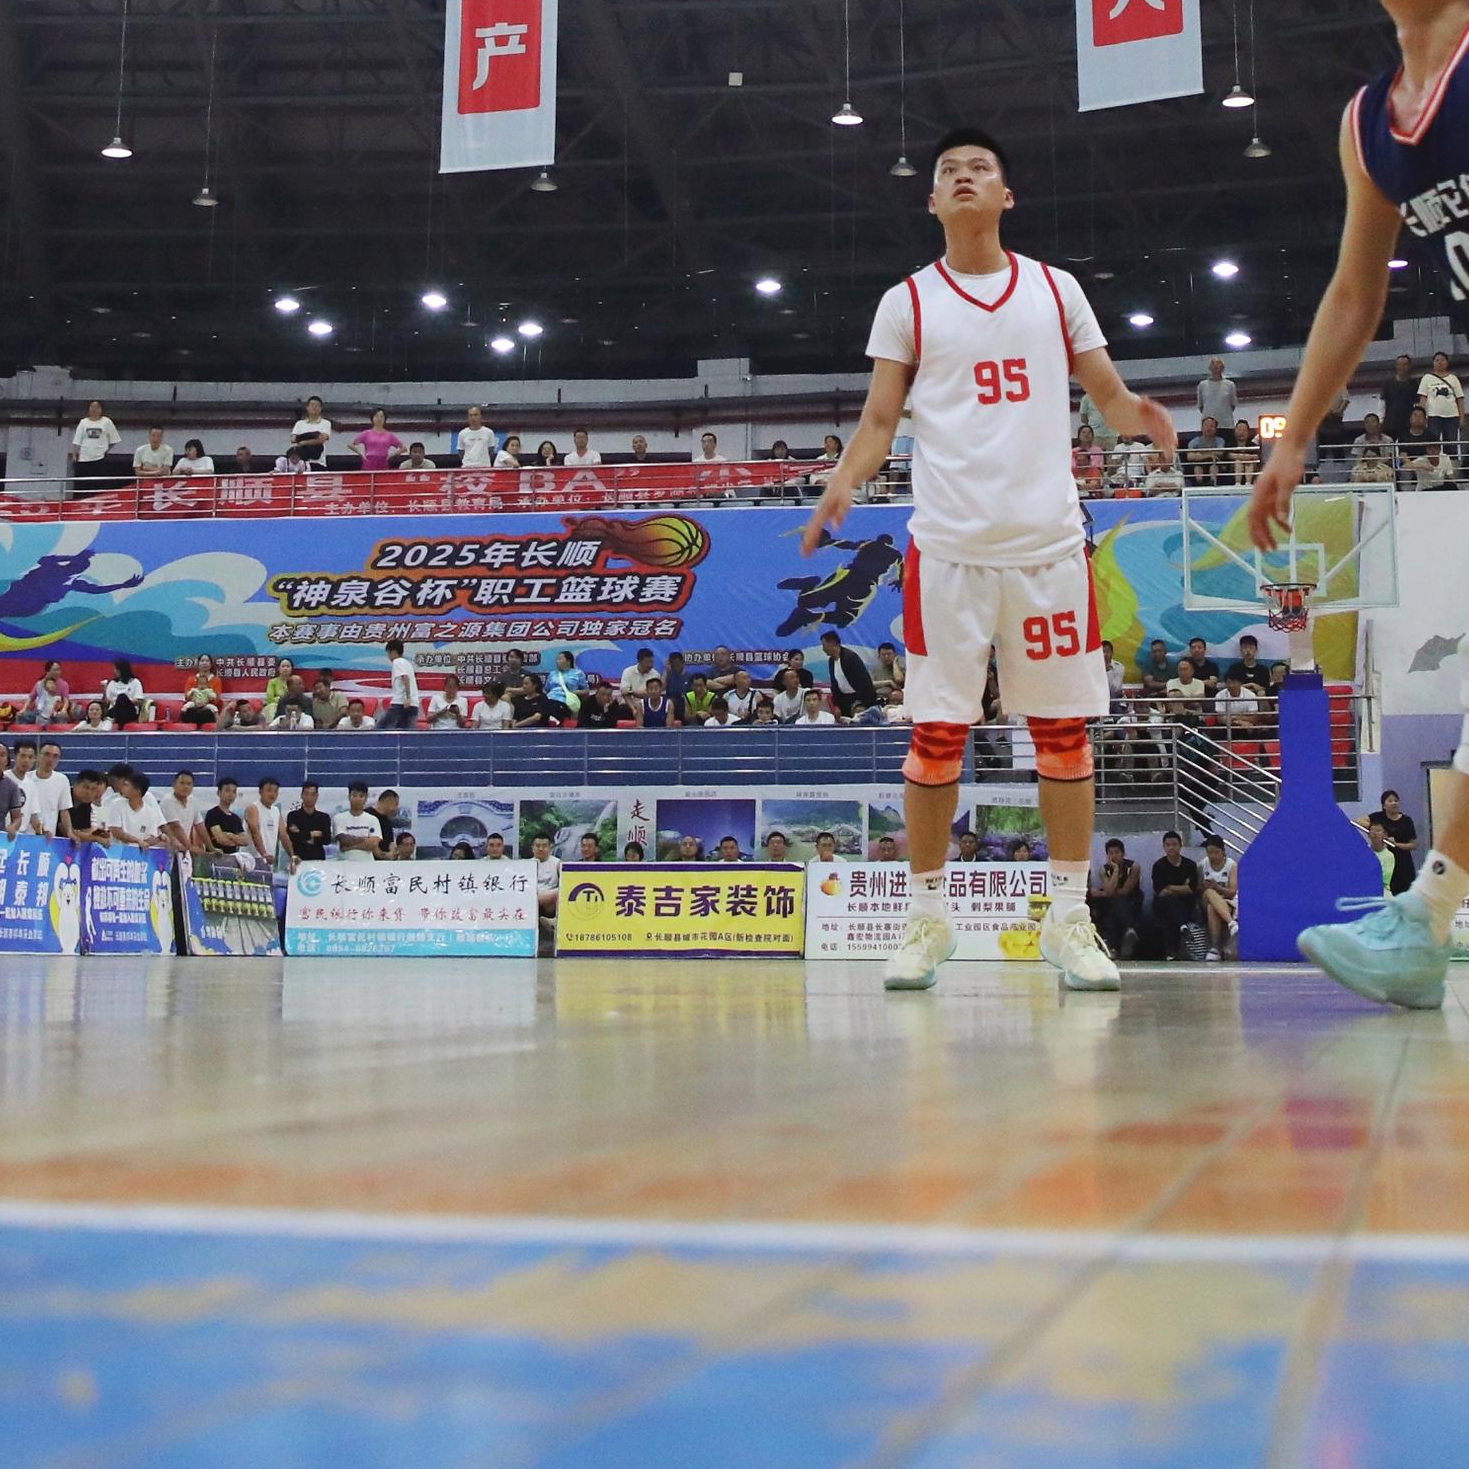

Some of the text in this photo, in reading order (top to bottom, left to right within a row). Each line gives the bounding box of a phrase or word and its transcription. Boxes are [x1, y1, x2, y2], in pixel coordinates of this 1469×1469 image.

[974, 357, 1030, 405] 95
[376, 540, 601, 570] 2025年长顺
[277, 574, 683, 609] “神泉谷杯”职工篮球赛
[270, 619, 680, 643] 本赛事由贵州富之源集团公司独家冠名
[1023, 611, 1080, 661] 95
[330, 873, 528, 895] 长顺富民村镇银行
[849, 869, 1048, 898] 贵州进品有限公司
[615, 884, 796, 919] 泰吉家装饰
